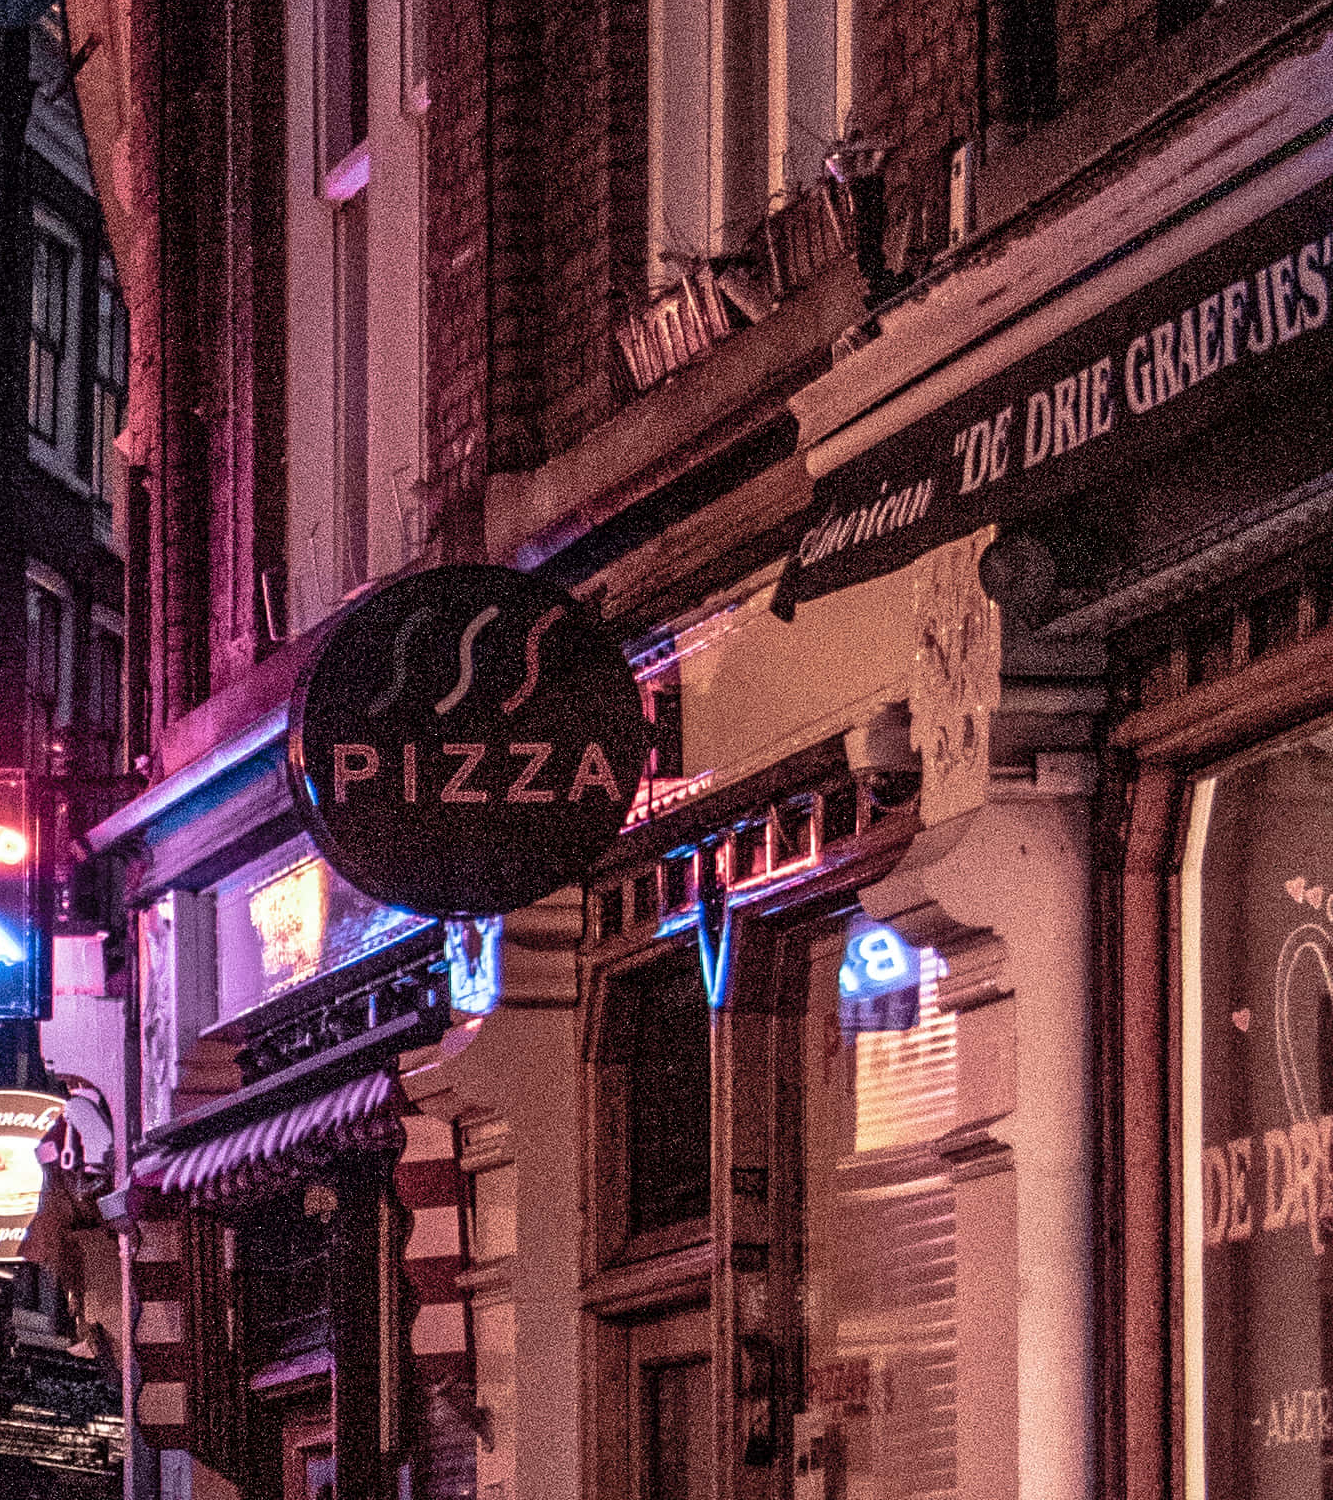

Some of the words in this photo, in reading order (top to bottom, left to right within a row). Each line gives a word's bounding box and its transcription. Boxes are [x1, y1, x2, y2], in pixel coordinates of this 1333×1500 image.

[1023, 355, 1116, 470] DRIE
[332, 742, 623, 804] PIZZA
[1203, 1137, 1253, 1248] DE
